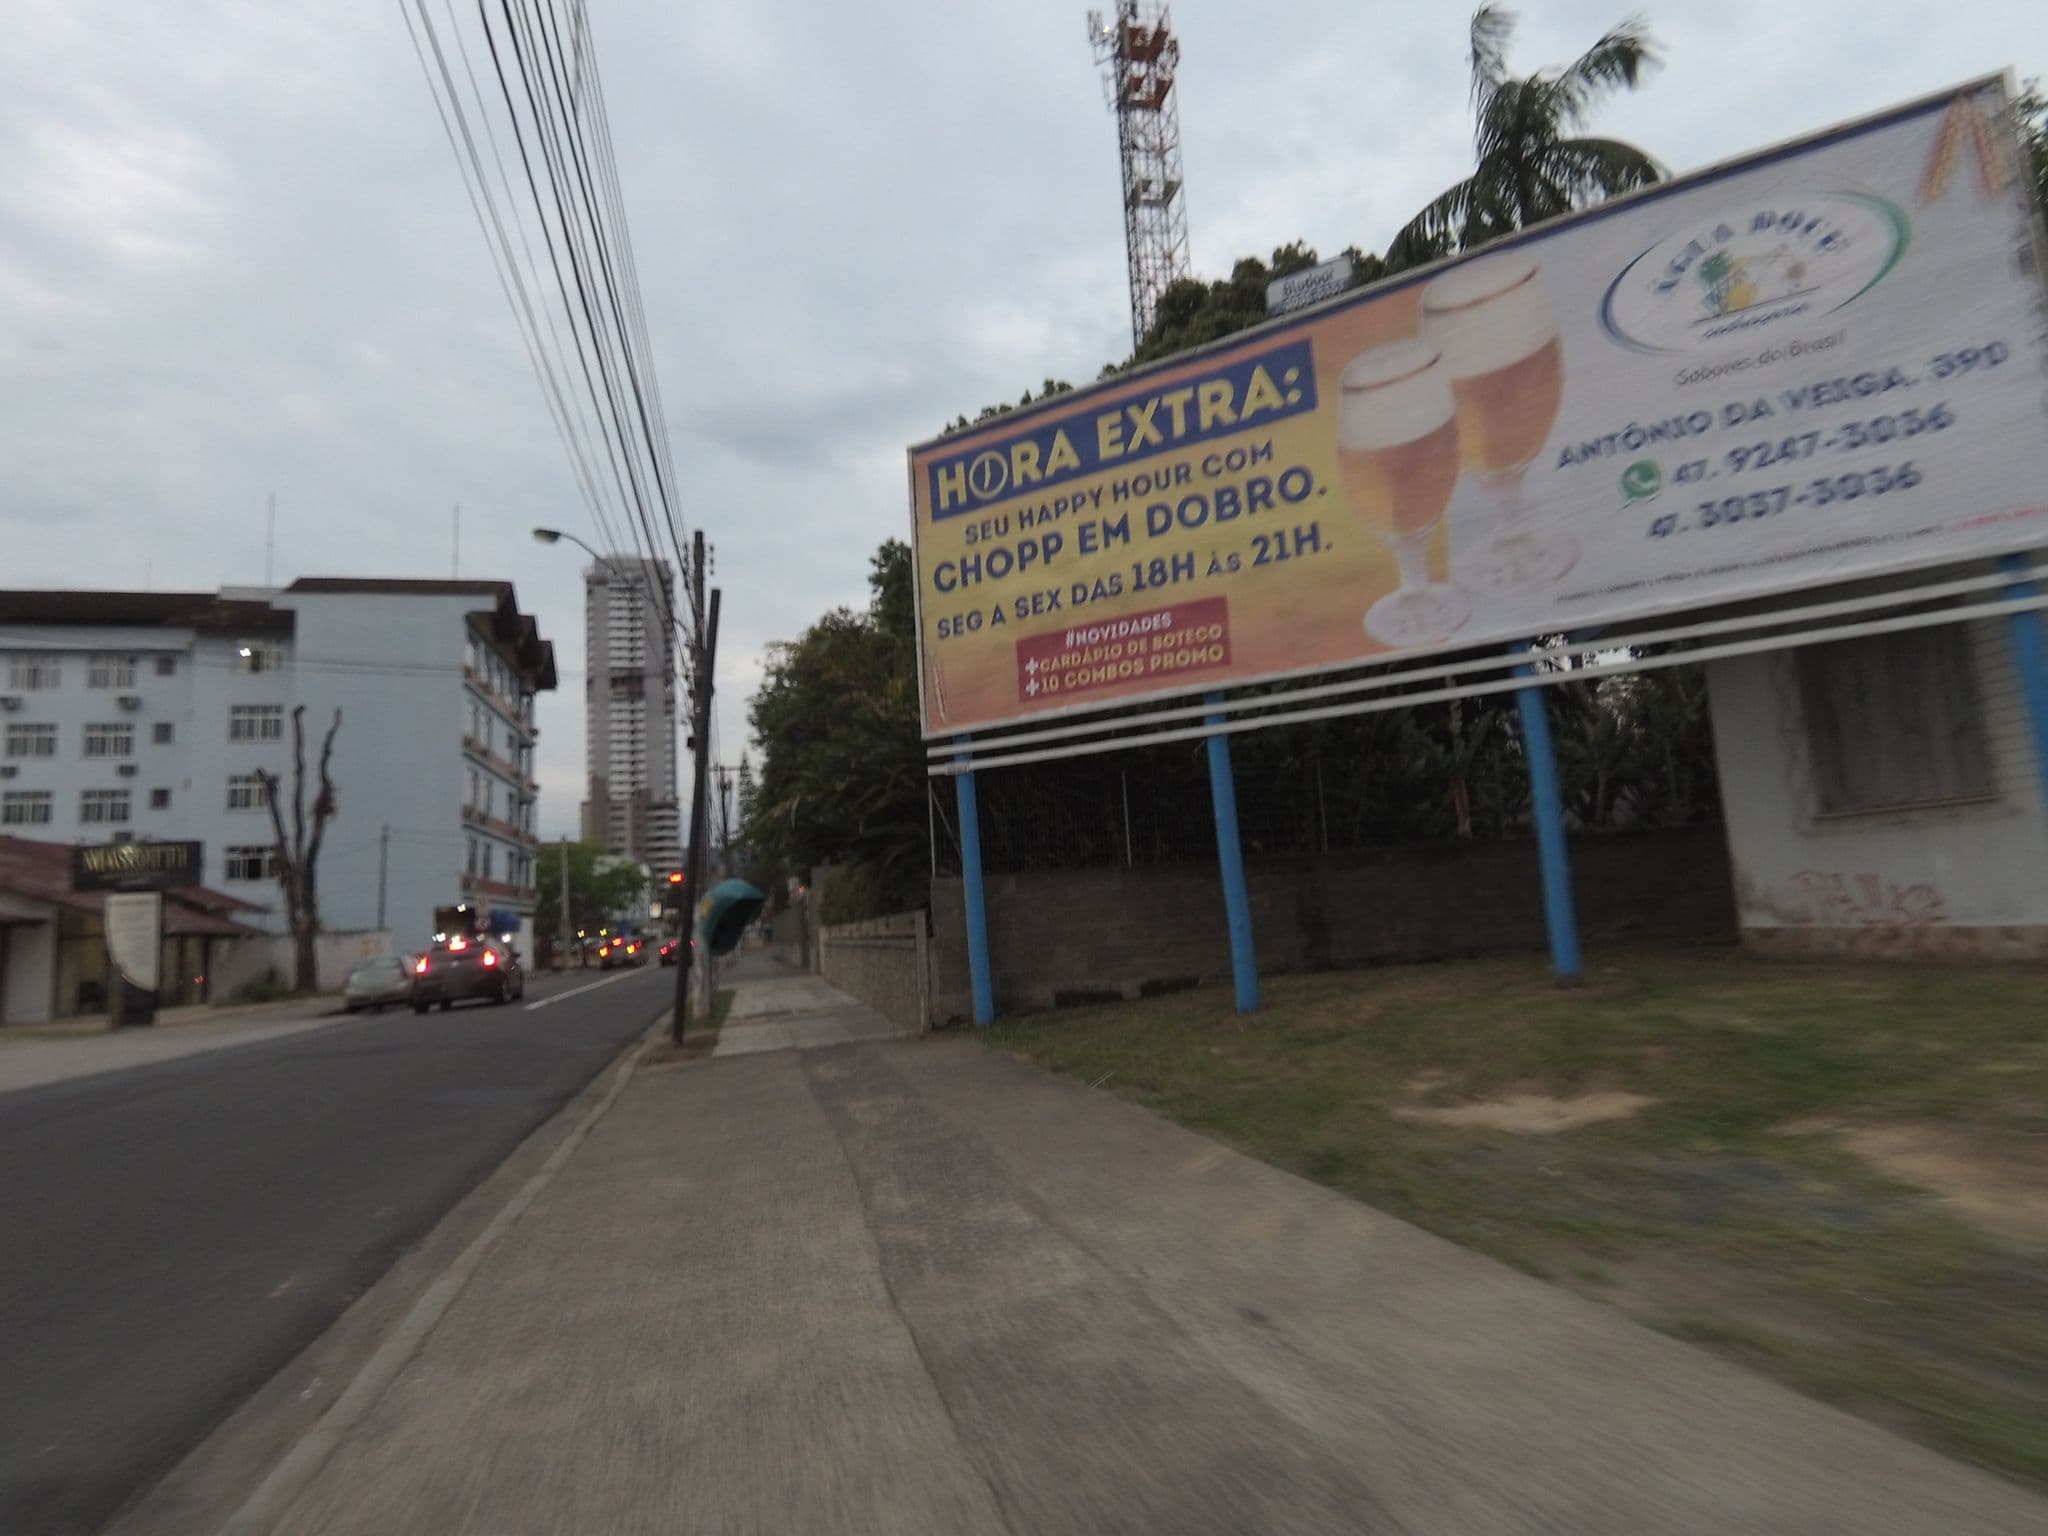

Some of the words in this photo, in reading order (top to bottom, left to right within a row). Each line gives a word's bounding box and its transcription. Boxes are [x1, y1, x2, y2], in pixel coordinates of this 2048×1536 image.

[1556, 410, 1713, 470] ANTÔNIO
[1720, 397, 1775, 428] DA
[1930, 340, 2009, 379] 390
[1673, 356, 1750, 388] Sabores
[937, 428, 1081, 511] HORA
[1097, 364, 1302, 462] EXTRA:
[933, 531, 1064, 593] CHOPP
[1078, 512, 1131, 555] EM
[1146, 464, 1328, 539] DOBRO.
[965, 514, 1009, 545] SEU
[1018, 484, 1104, 531] HAPPY
[1112, 462, 1192, 503] HOUR
[1202, 438, 1274, 478] COM
[937, 609, 983, 640] SEG
[990, 603, 1006, 628] A
[1014, 587, 1063, 620] SEX
[1071, 572, 1123, 606] DAS
[1132, 550, 1195, 592] 18H
[1252, 520, 1334, 567] 21H.
[1064, 611, 1173, 650] #NOVIDADES
[1064, 657, 1145, 687] COMBOS
[1150, 644, 1225, 671] PROMO
[1127, 638, 1148, 656] DE
[1152, 623, 1223, 651] BOTECO
